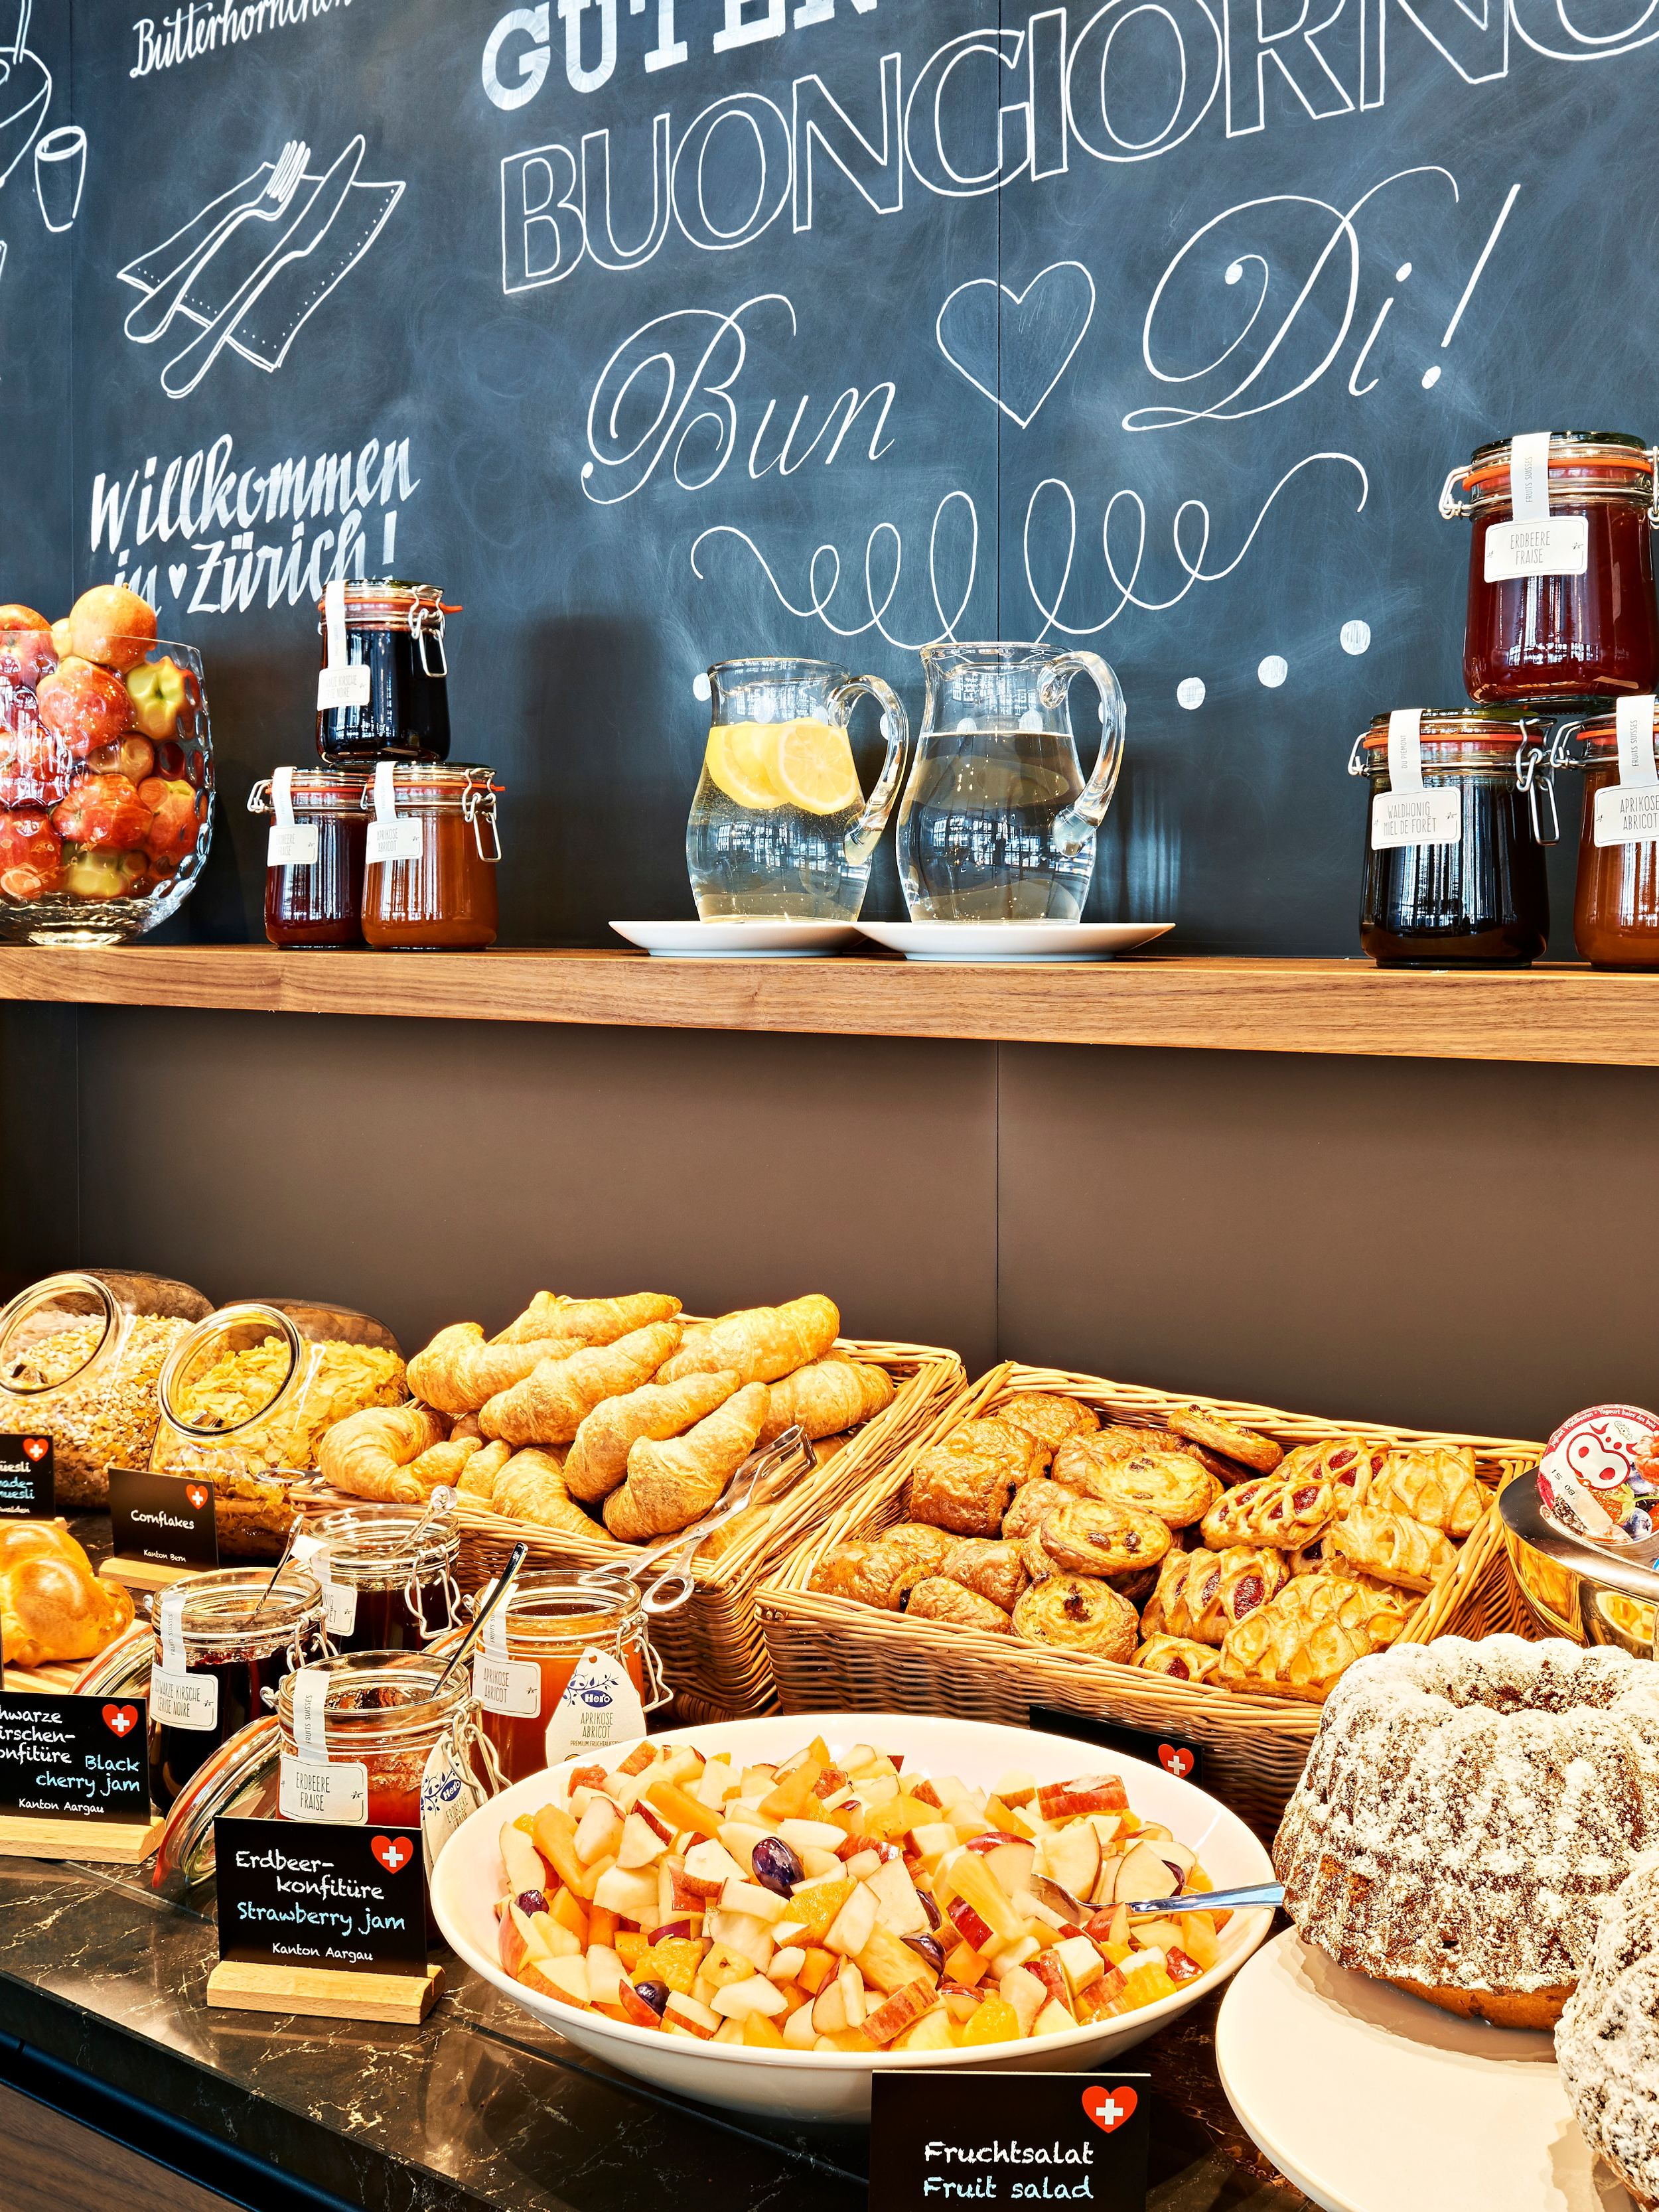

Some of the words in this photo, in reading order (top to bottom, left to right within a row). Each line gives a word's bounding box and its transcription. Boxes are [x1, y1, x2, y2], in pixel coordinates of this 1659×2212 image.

[581, 294, 896, 504] Bun
[1524, 456, 1533, 480] SUISSES
[90, 433, 421, 553] Willkommen
[1510, 531, 1551, 549] ERDBEERE
[187, 509, 397, 614] Zürich!
[1516, 549, 1544, 565] FRAISE
[1387, 801, 1430, 819] WALDHONIG
[1383, 819, 1398, 837] MIEL
[1400, 819, 1409, 835] DE
[1411, 816, 1437, 833] FORÊT
[1623, 812, 1658, 831] ABRICOT
[131, 1509, 194, 1529] Cornflakes
[143, 1549, 168, 1559] Kanton
[170, 1553, 186, 1562] Bern
[483, 1667, 510, 1687] APRIKOSE
[484, 1685, 507, 1703] ABRICOT
[585, 1693, 611, 1703] Hero
[580, 1712, 614, 1725] APRIKOSE
[582, 1725, 611, 1738] ABRICOT
[85, 1754, 140, 1771] Black
[36, 1770, 95, 1798] cherry
[100, 1773, 140, 1797] jam
[296, 1772, 330, 1793] ERDBEERE
[443, 1781, 461, 1800] Hero
[19, 1798, 60, 1810] Kanton
[64, 1801, 104, 1816] Aargau
[300, 1792, 325, 1811] FRAISE
[236, 1848, 334, 1872] Erdbeer-
[276, 1874, 385, 1901] konfitüre
[237, 1901, 352, 1936] Strawberry
[358, 1907, 405, 1935] jam
[272, 1942, 321, 1957] Kanton
[325, 1947, 373, 1963] Aargau
[924, 2140, 1094, 2165] Fruchtsalat
[923, 2176, 997, 2199] Fruit
[1011, 2175, 1094, 2199] salad
